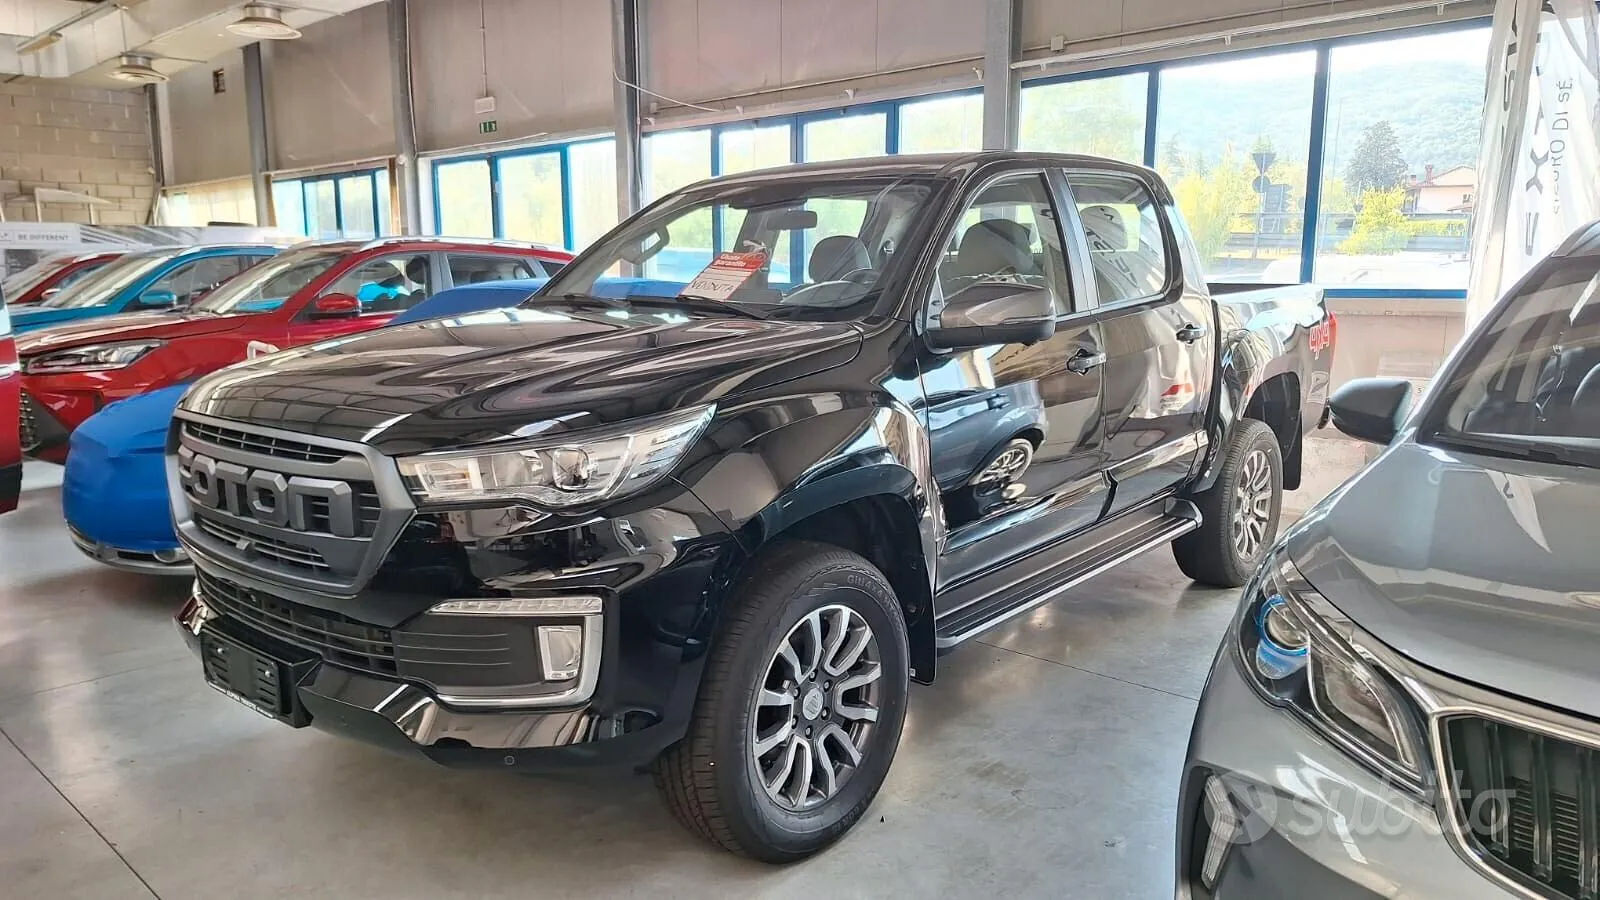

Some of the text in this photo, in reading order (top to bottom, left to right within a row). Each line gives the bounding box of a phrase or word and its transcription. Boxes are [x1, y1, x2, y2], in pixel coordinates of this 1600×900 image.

[1552, 111, 1569, 131] DI
[18, 233, 28, 241] BE
[29, 233, 69, 241] DIFFERENT
[178, 444, 355, 538] FOTON
